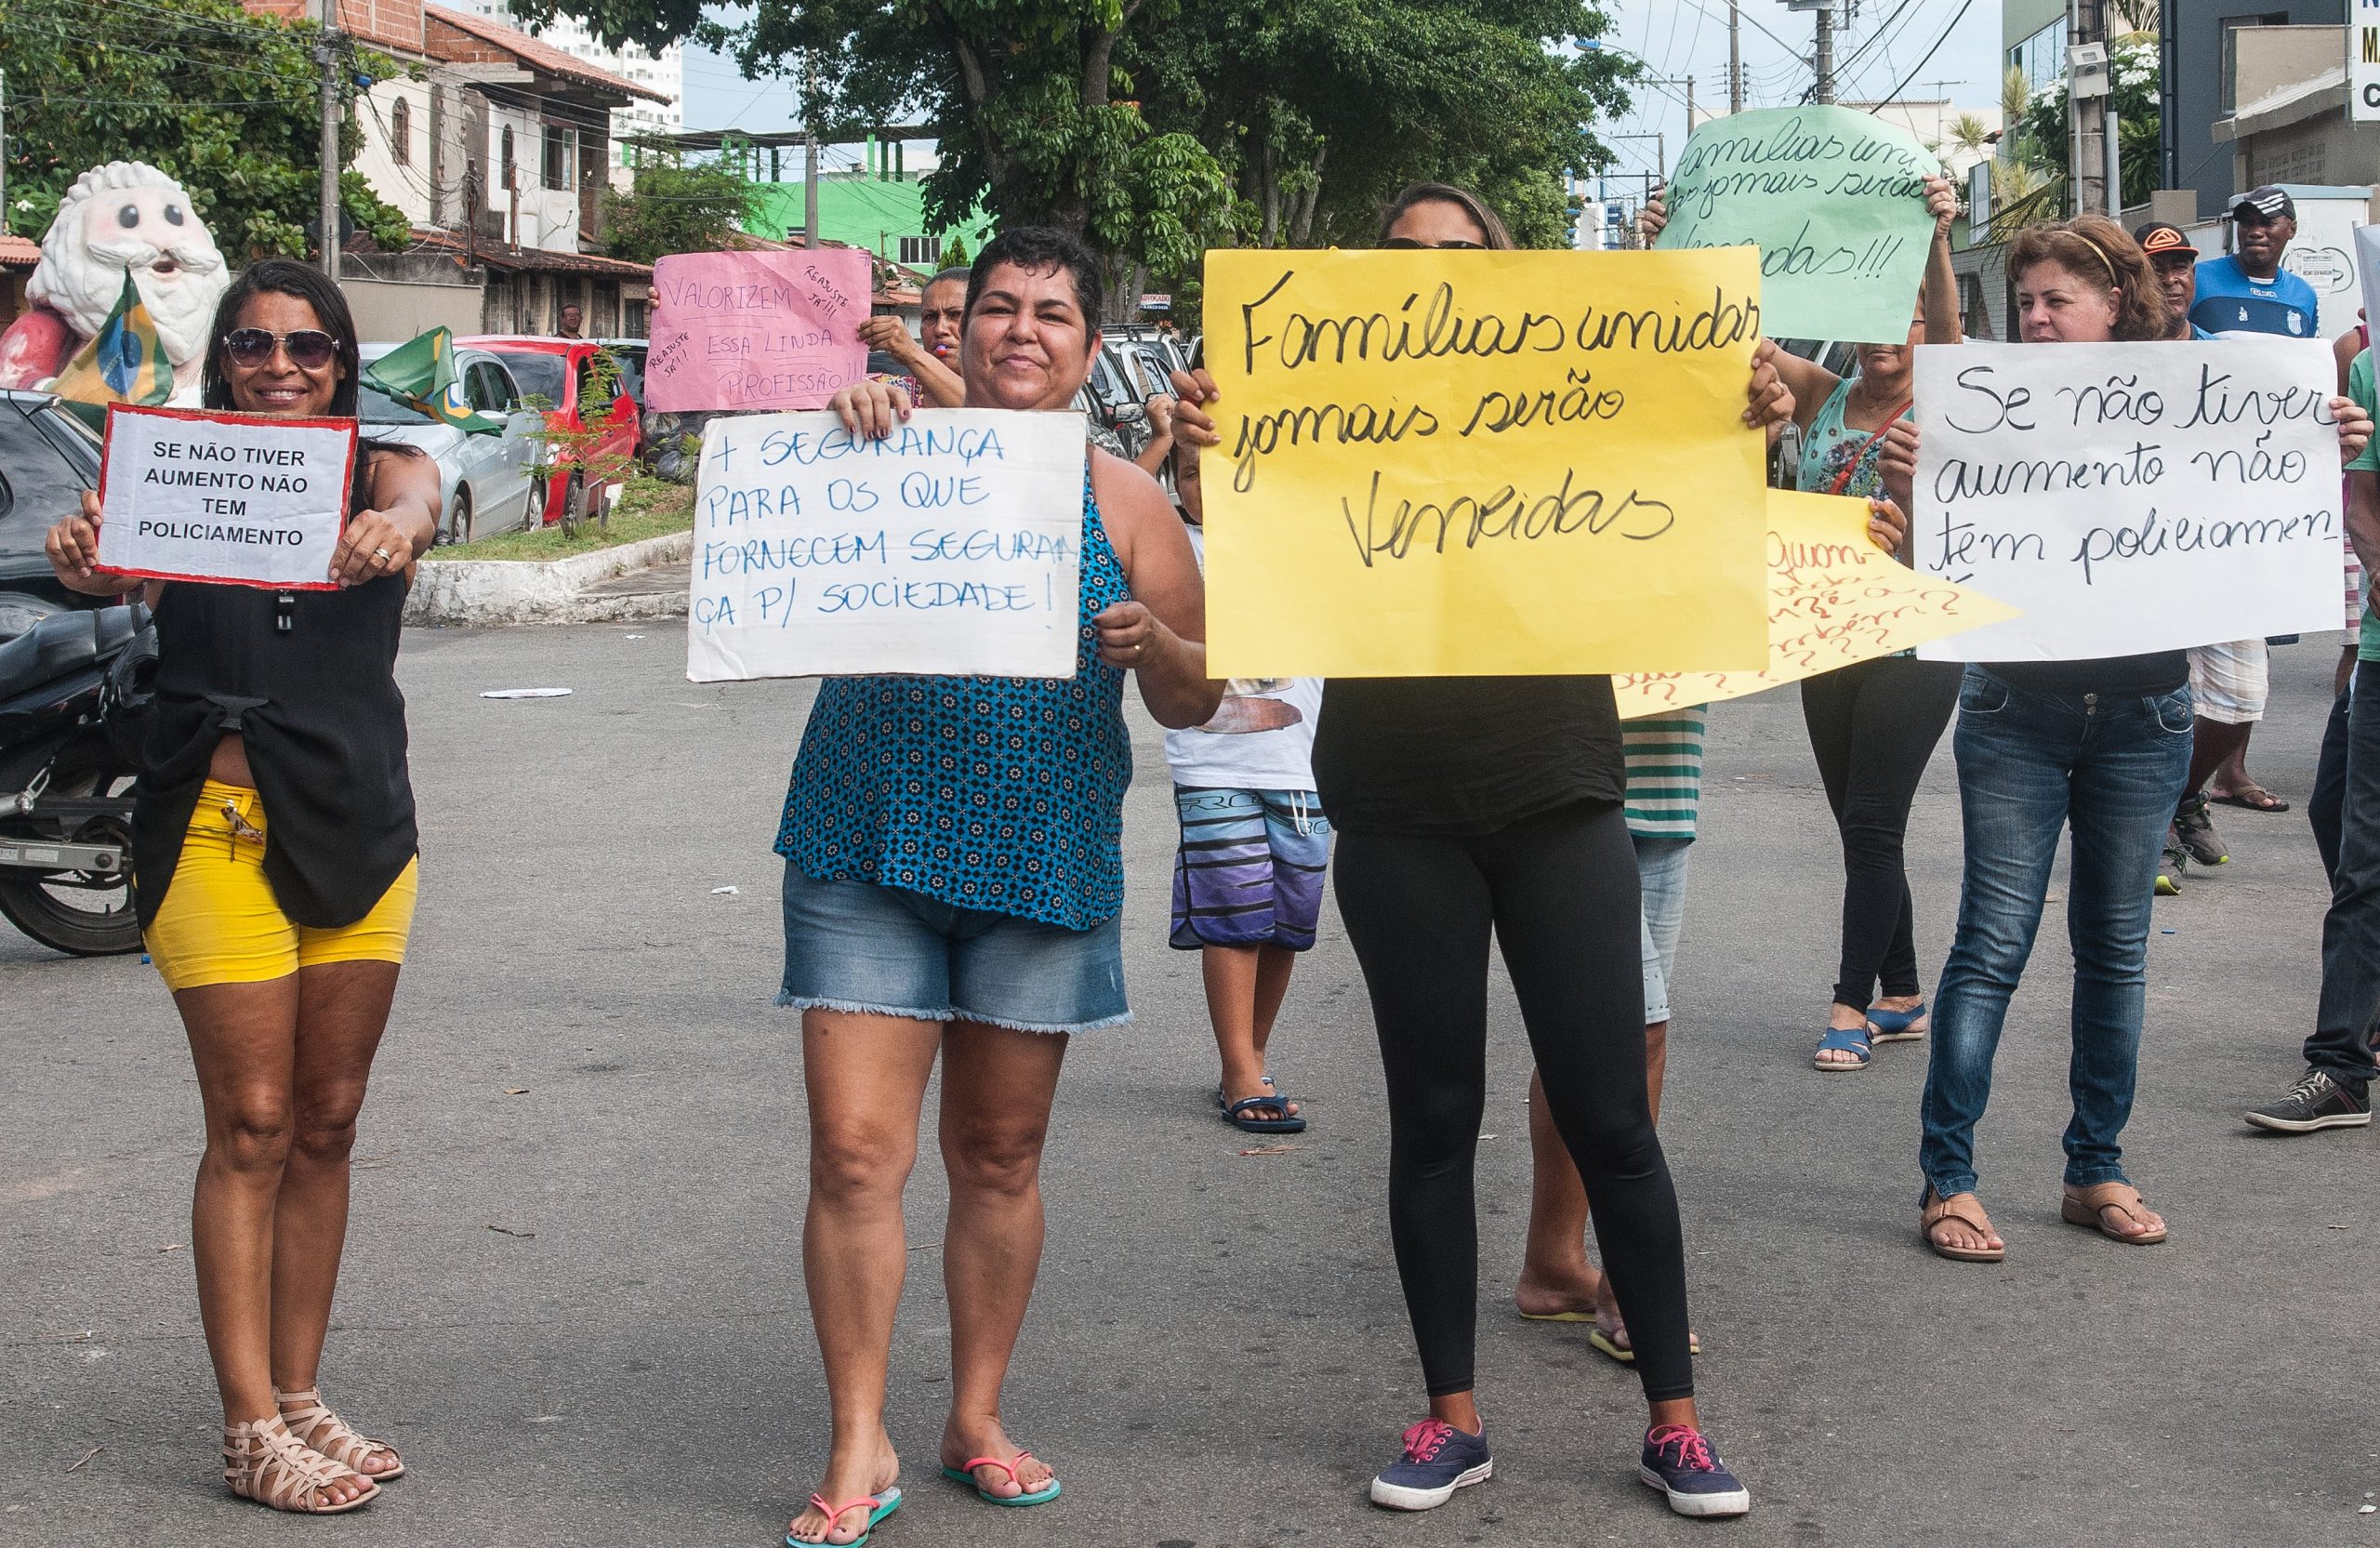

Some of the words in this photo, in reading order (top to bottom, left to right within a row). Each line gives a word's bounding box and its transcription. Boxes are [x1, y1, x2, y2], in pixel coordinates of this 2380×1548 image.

[664, 277, 791, 311] VALORIZEM
[803, 265, 849, 309] REAJUSTE
[707, 335, 750, 355] ESSA
[765, 328, 833, 352] LINDA
[1242, 271, 1564, 376] Famílias
[649, 331, 690, 369] REAJUSTE
[1460, 366, 1626, 437] serão
[1945, 365, 2036, 434] Se
[2056, 374, 2164, 426] não
[2173, 363, 2340, 430] tiver
[153, 442, 181, 459] SE
[189, 442, 236, 462] NÃO
[244, 447, 305, 466] TIVER
[711, 435, 737, 471] +
[760, 426, 1004, 467] SEGURANÇA
[1935, 441, 2165, 504] aumento
[2190, 430, 2307, 483] não
[144, 468, 254, 490] AUMENTO
[261, 473, 308, 494] NÃO
[702, 484, 800, 528] PARA
[827, 478, 879, 512] OS
[901, 471, 989, 508] QUE
[202, 498, 246, 516] TEM
[139, 521, 303, 546] POLICIAMENTO
[704, 530, 886, 580] FORNECEM
[1929, 511, 2045, 571] tem
[694, 596, 736, 635] ÇA
[753, 577, 796, 628] P/
